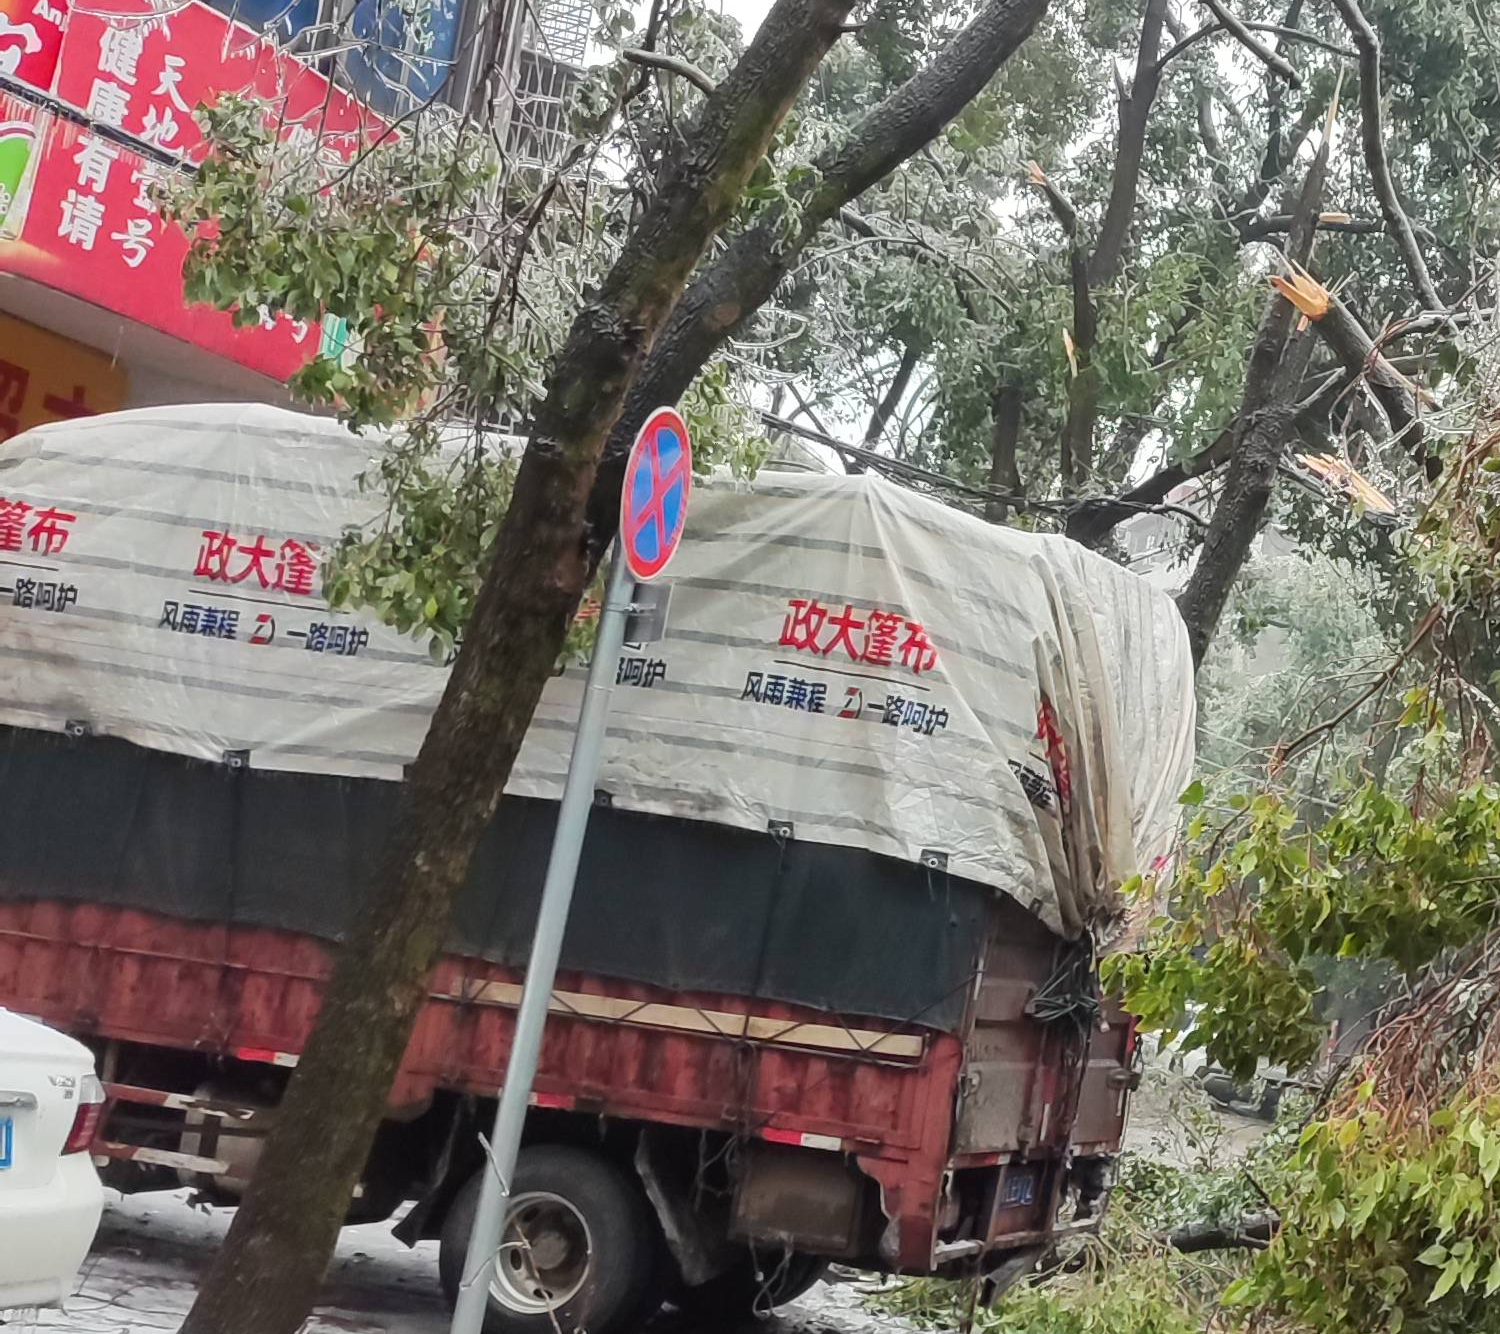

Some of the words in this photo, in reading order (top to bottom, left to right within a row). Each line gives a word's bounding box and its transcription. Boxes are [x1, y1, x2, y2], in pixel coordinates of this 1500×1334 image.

[57, 26, 144, 251] 健康有请
[111, 54, 190, 268] 天地壹号
[158, 600, 241, 640] 风雨兼程
[286, 621, 369, 657] 一路呵护
[778, 598, 938, 675] 政大篷布
[615, 656, 667, 688] 呵护
[740, 671, 828, 714] 风雨兼程
[867, 694, 950, 736] 一路呵护
